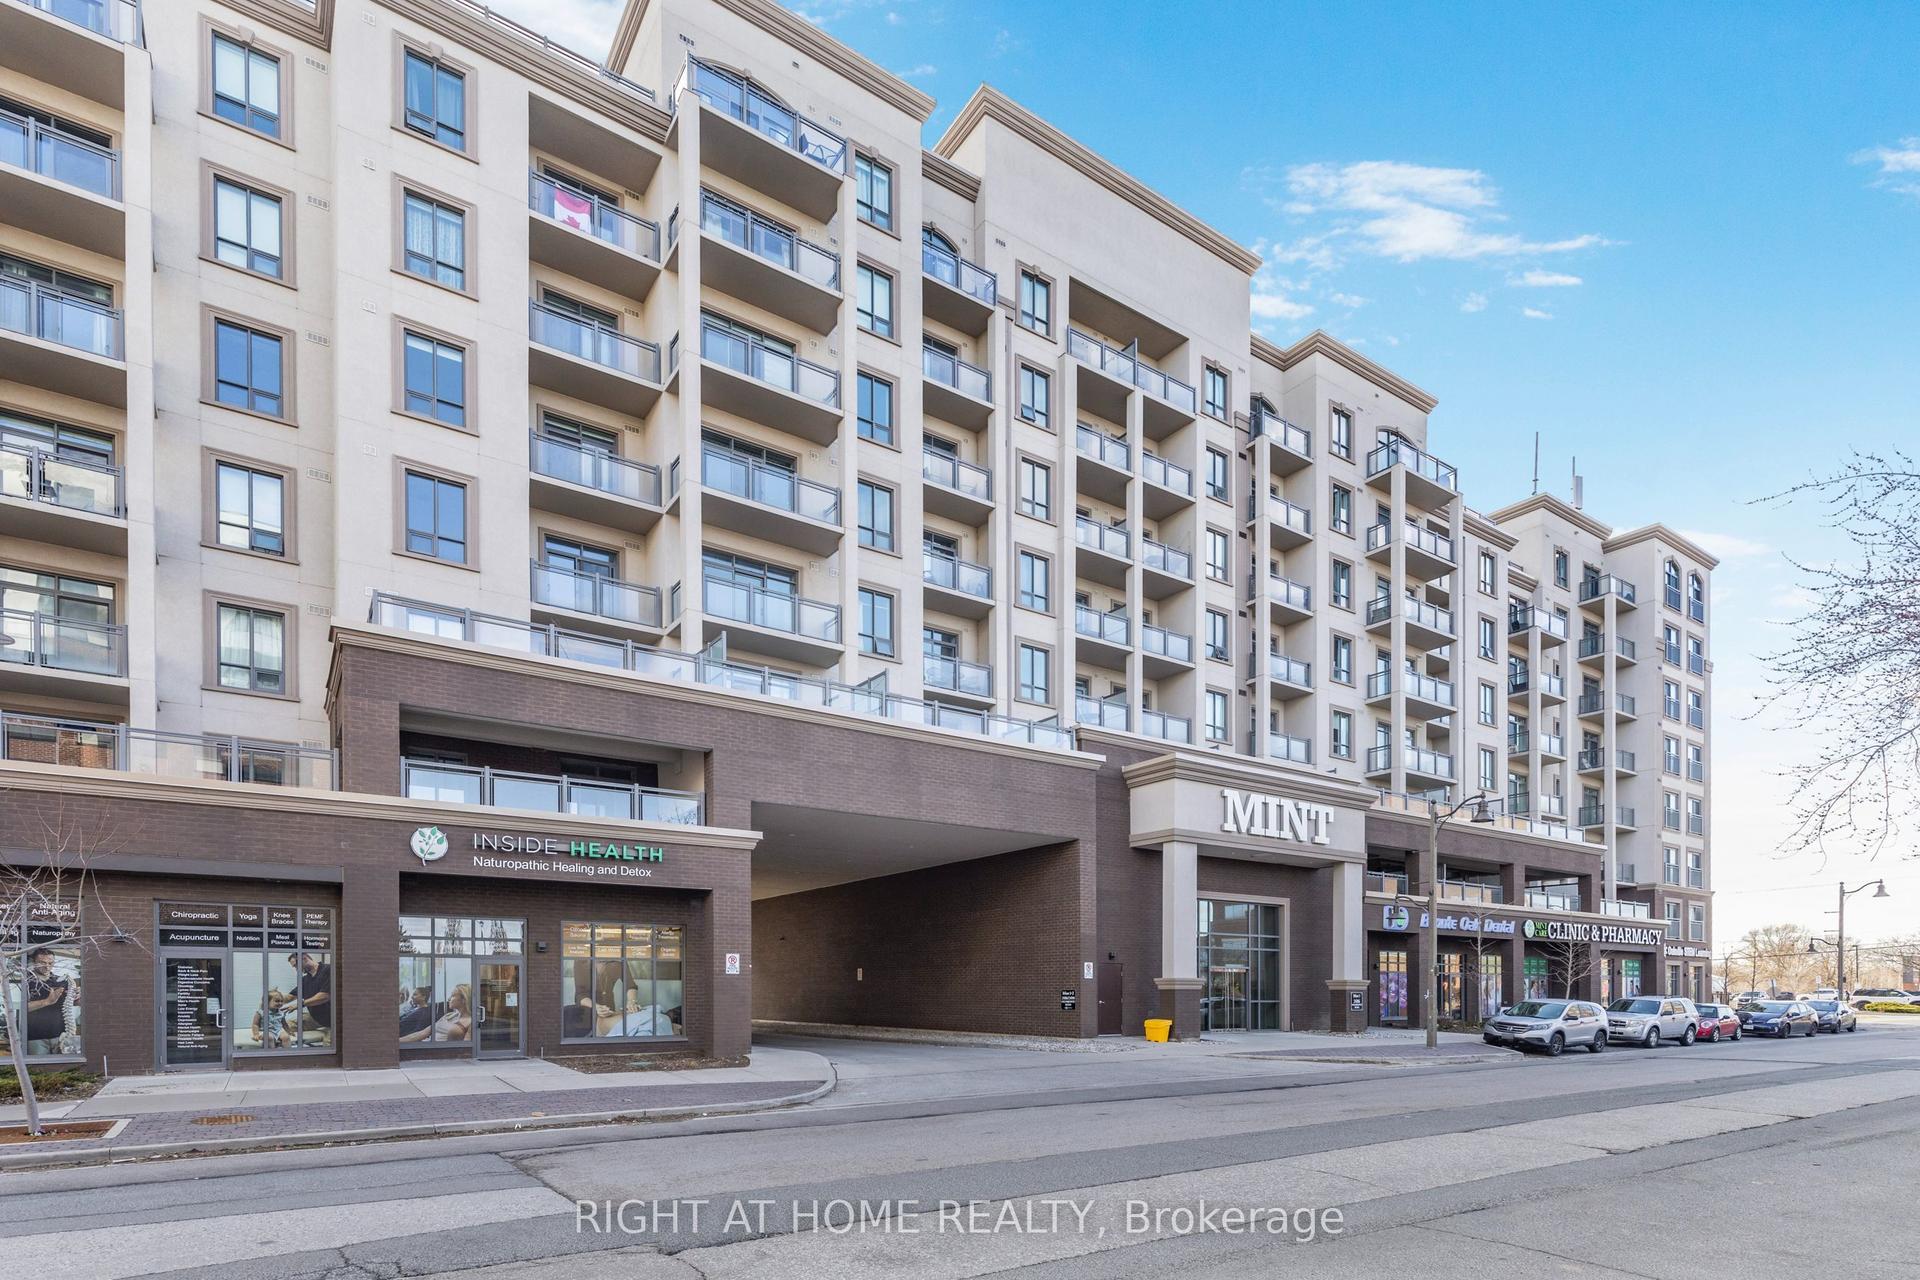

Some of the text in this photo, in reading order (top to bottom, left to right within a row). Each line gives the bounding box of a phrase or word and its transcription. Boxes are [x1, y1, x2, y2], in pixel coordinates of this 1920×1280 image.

[1221, 788, 1334, 845] MINT
[473, 833, 664, 863] INSIDE HEALTH
[473, 856, 652, 877] Naturopathic Healing and Detox
[171, 911, 219, 919] Chiropractic
[1484, 918, 1516, 934] Dental
[1548, 921, 1663, 945] CLINIC & PHARMACY
[169, 933, 220, 941] Acupuncture
